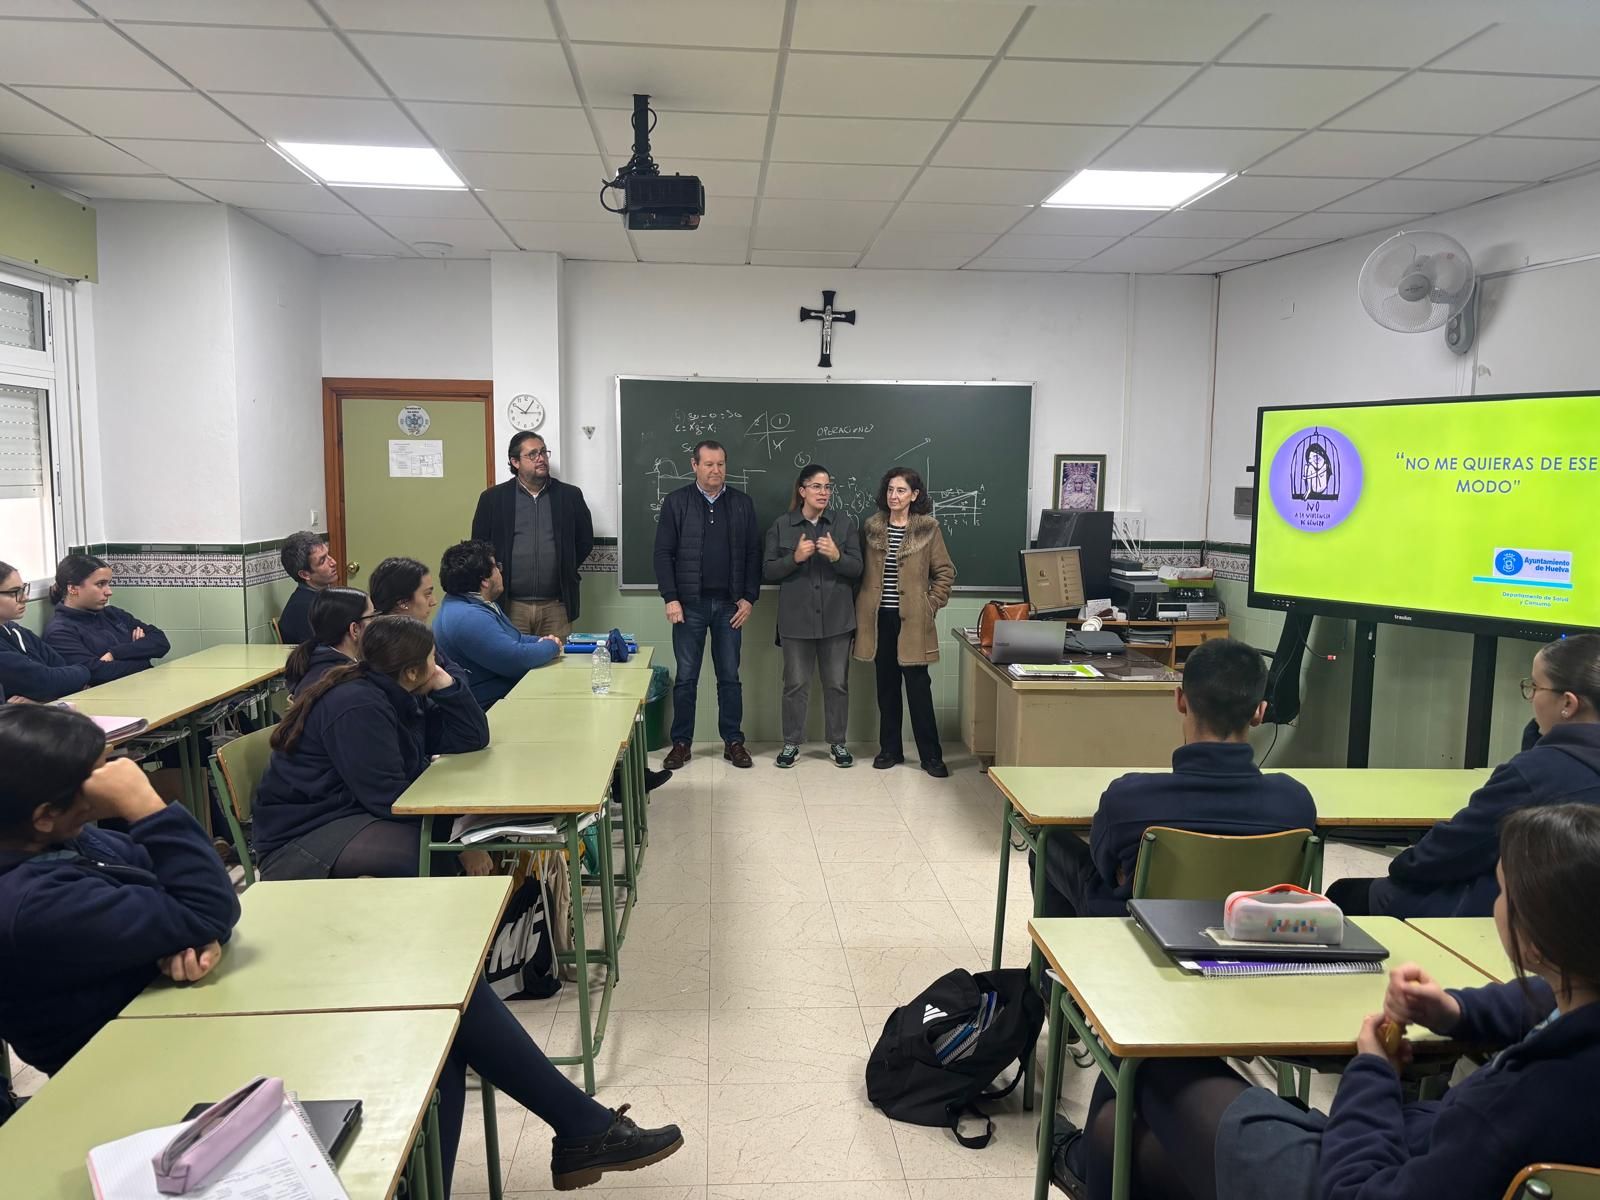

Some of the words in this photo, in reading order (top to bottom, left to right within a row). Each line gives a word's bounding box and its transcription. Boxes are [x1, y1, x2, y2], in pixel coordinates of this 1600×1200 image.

[1434, 458, 1458, 470] ME
[1463, 457, 1534, 471] QUIERAS
[1540, 457, 1562, 470] DE
[1568, 457, 1598, 470] ESE
[1456, 480, 1520, 493] MODO”
[1306, 501, 1320, 512] NO
[1524, 557, 1570, 566] Ayuntamiento
